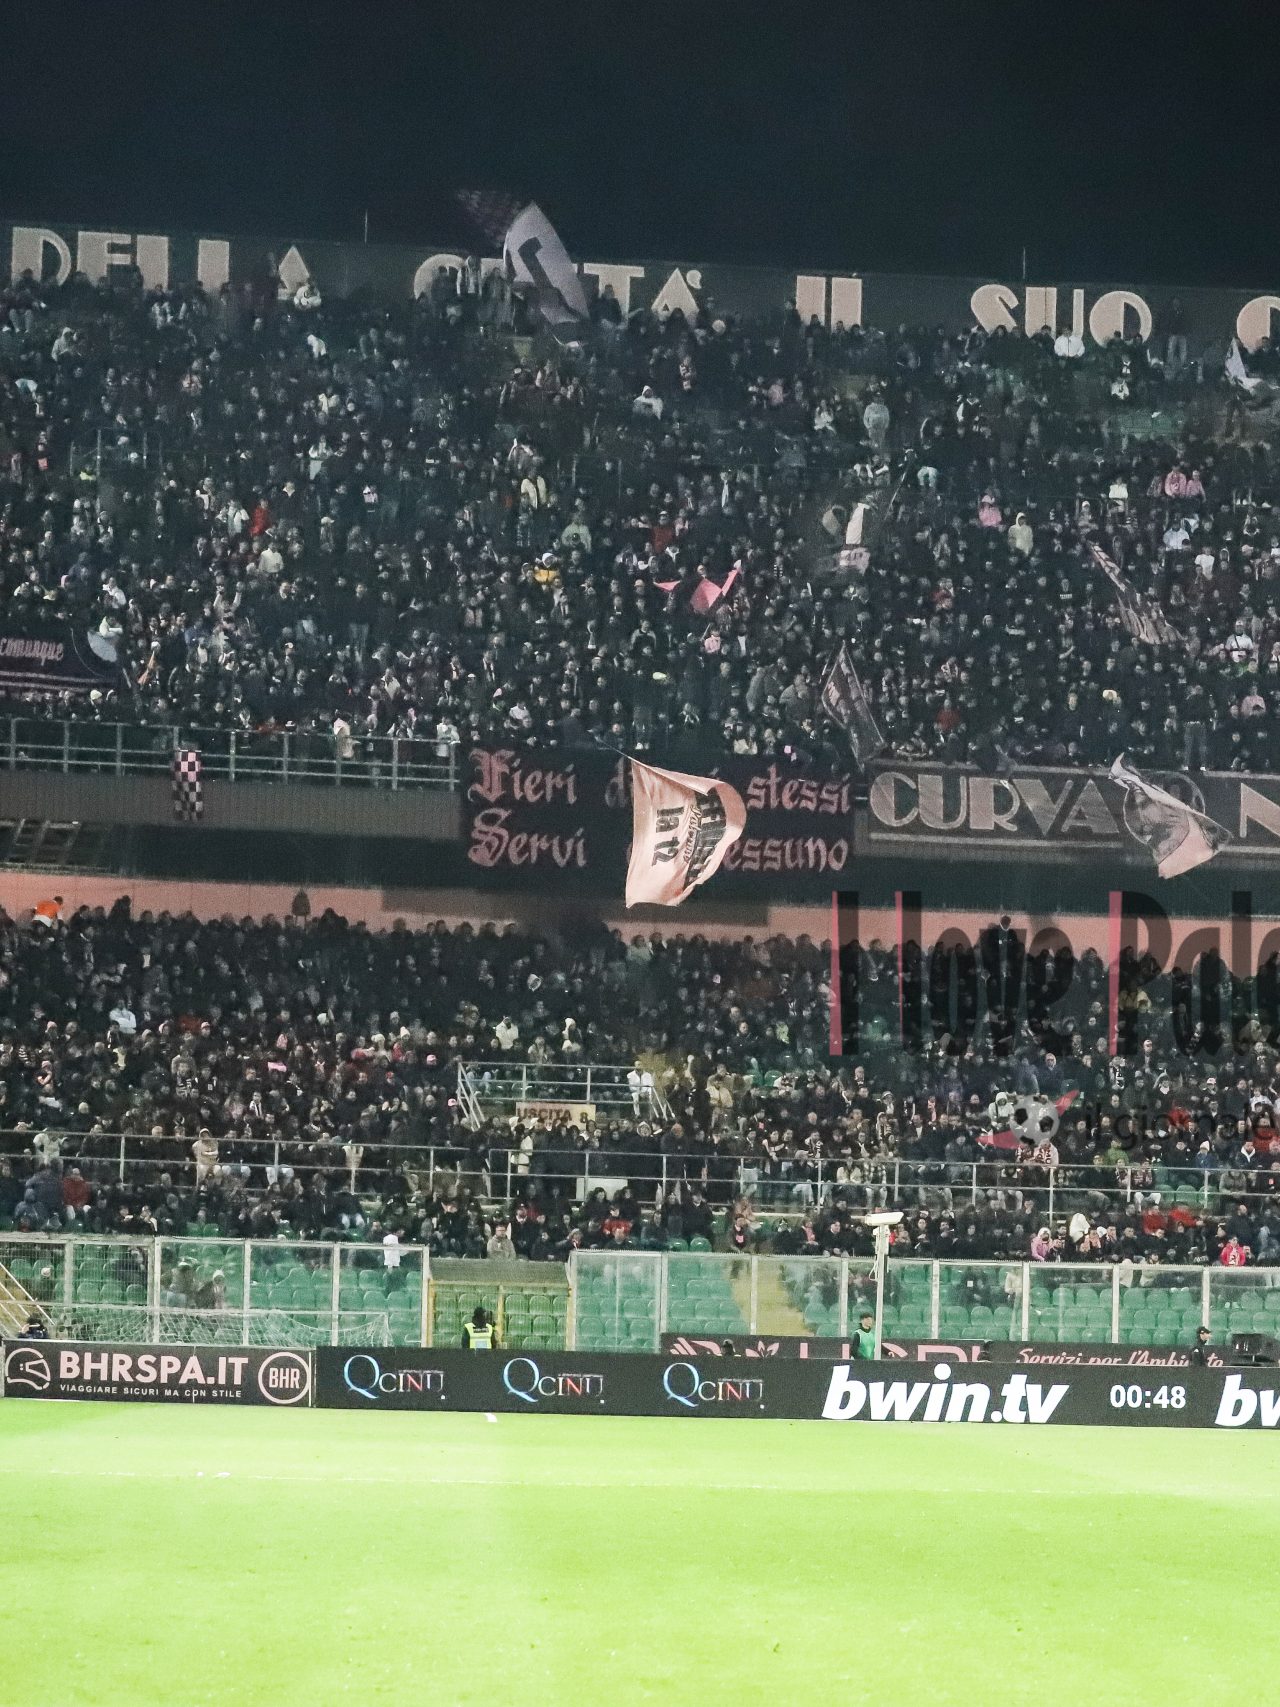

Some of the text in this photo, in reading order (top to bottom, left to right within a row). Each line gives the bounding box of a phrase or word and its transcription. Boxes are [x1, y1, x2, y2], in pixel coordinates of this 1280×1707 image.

[468, 747, 577, 804] Fieri
[747, 763, 851, 815] stessi
[870, 771, 1121, 837] CURVA
[468, 807, 588, 868] Servi
[720, 834, 850, 873] essuno
[59, 1350, 249, 1385] BHRSPA.IT
[60, 1384, 243, 1399] VIAGGIARE SICURI MA CON STILE
[269, 1367, 300, 1389] BHR
[821, 1363, 1071, 1424] bwin.tv
[1110, 1384, 1187, 1410] 00:48
